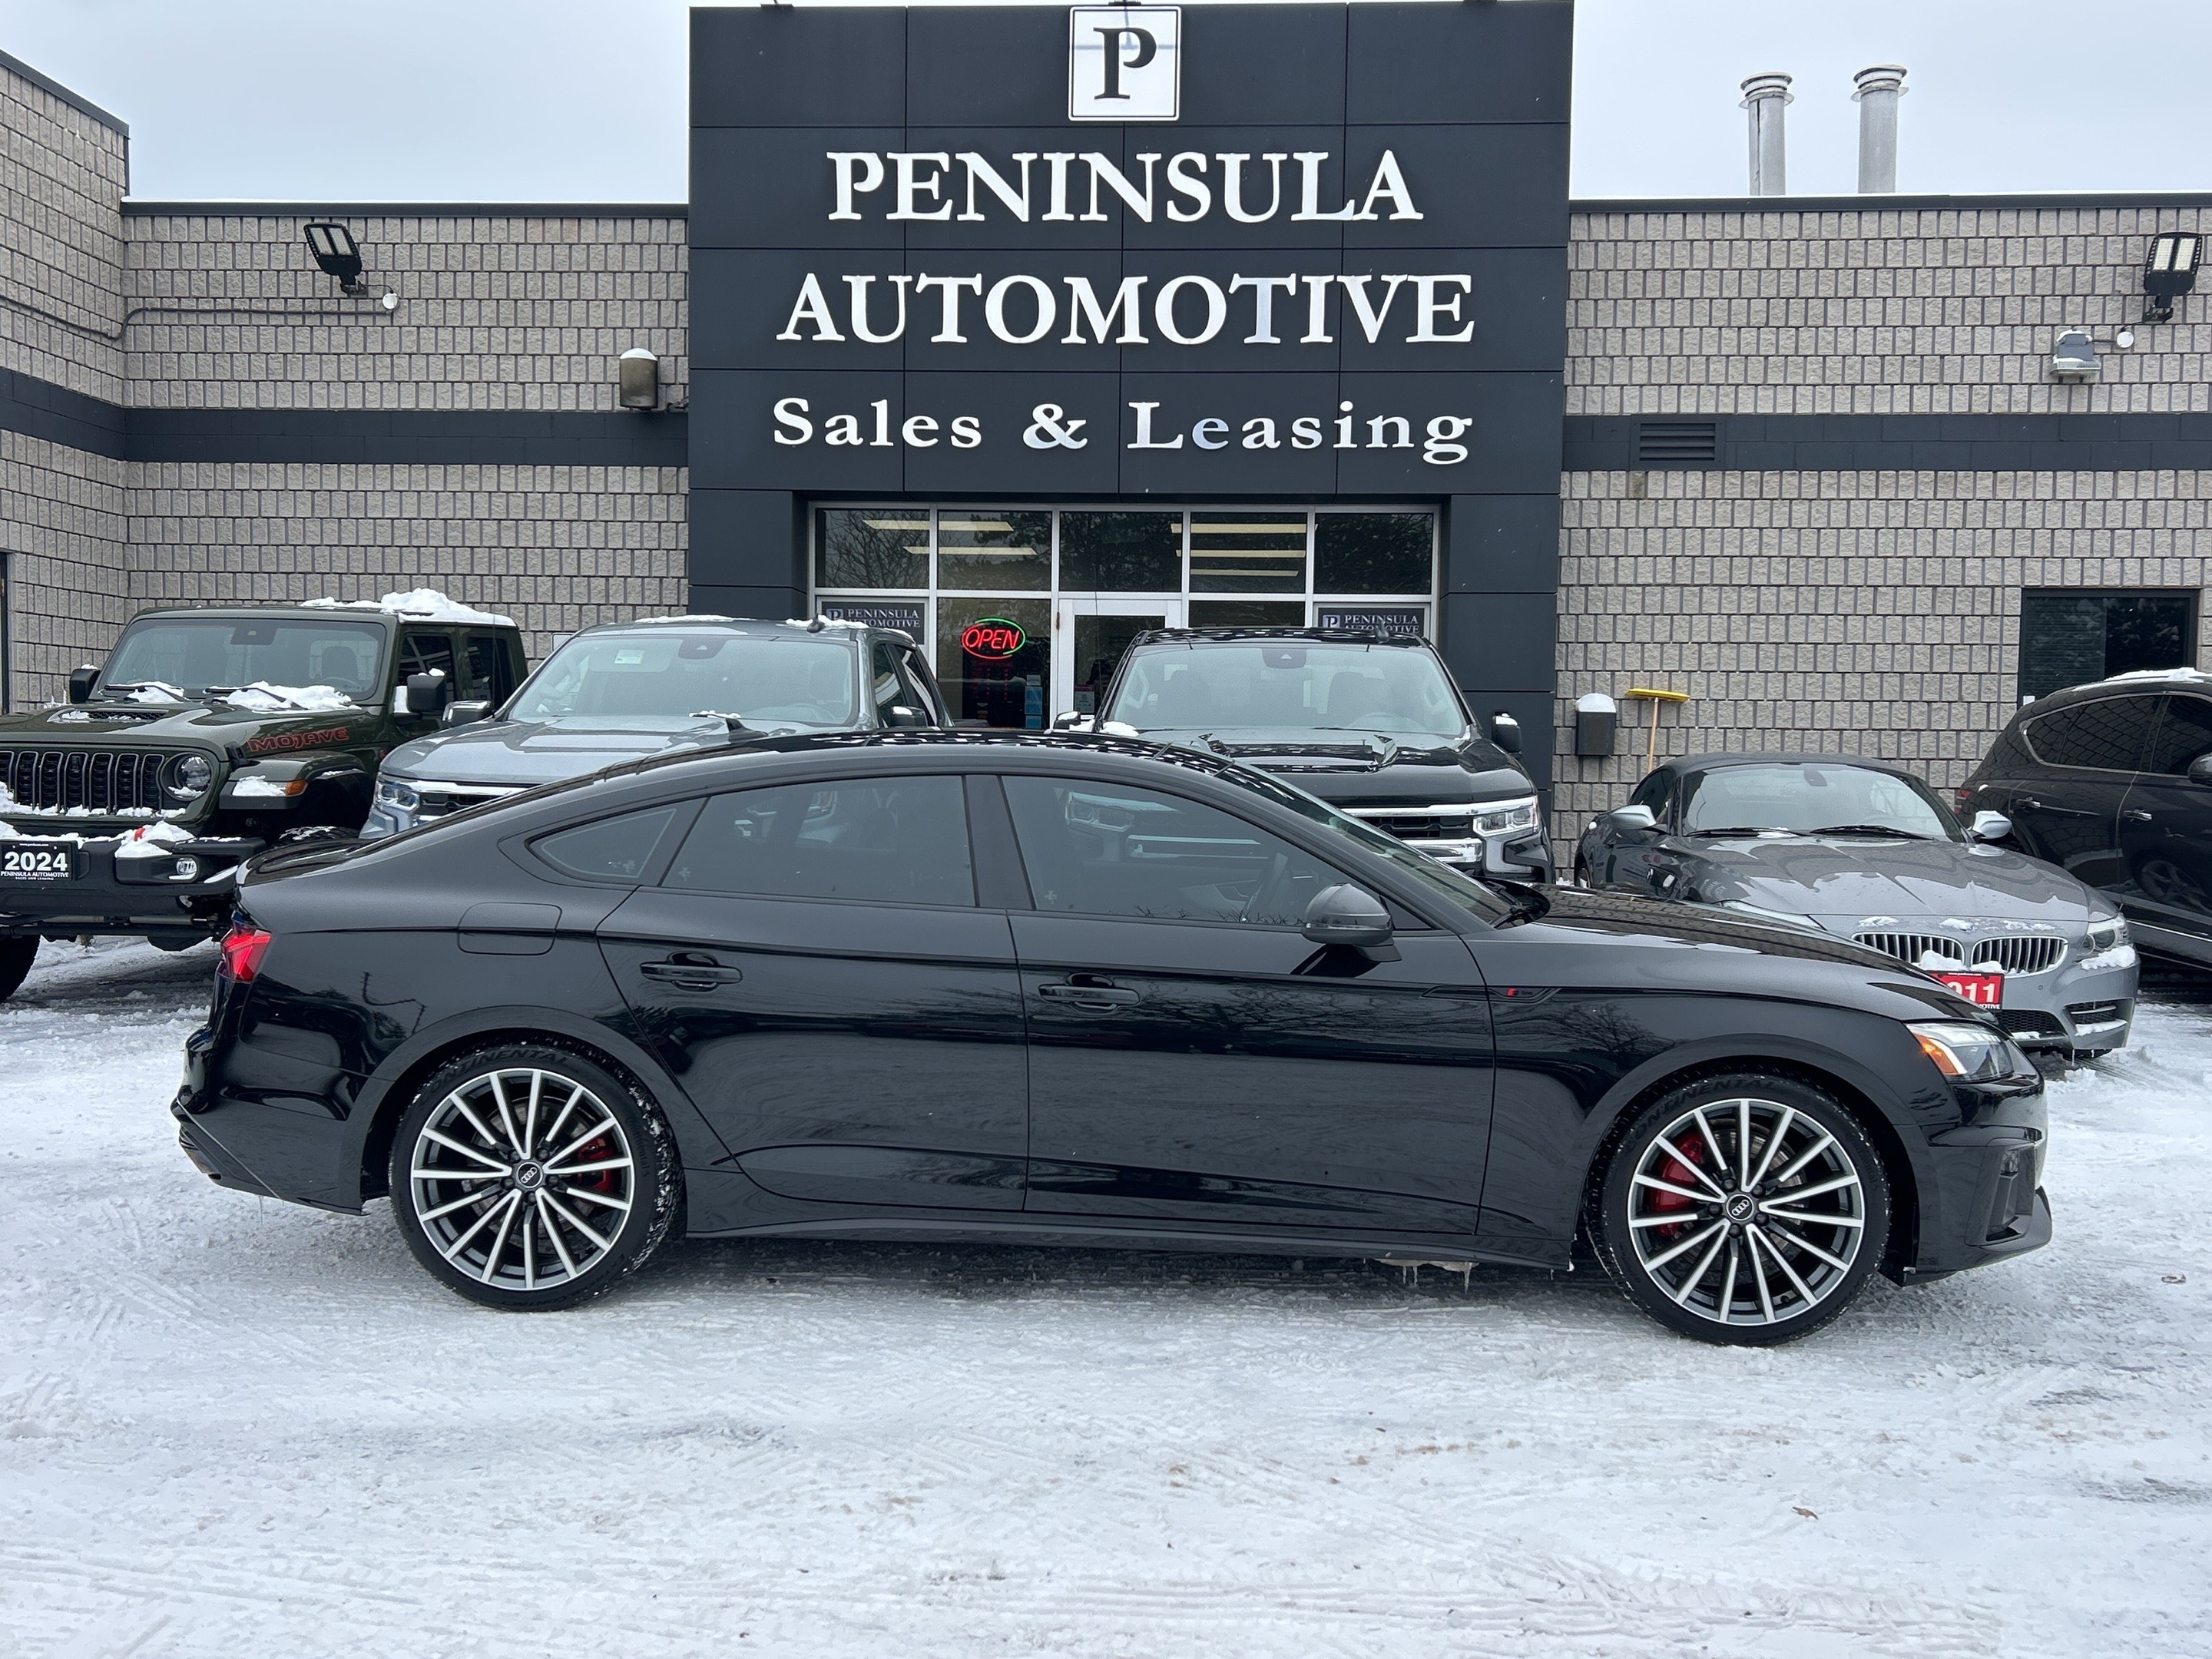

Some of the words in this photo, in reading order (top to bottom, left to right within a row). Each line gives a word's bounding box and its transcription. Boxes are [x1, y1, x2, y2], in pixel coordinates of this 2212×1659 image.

[1094, 28, 1156, 99] P
[826, 150, 1423, 223] PENINSULA
[777, 273, 1474, 344] AUTOMOTIVE
[774, 398, 981, 448] Sales
[1023, 404, 1088, 449] &
[1128, 401, 1472, 464] Leasing
[847, 608, 919, 619] PENINSULA
[849, 618, 920, 628] TOMOTIVE
[1344, 614, 1418, 624] PENINSULA
[965, 629, 1020, 649] OPEN
[247, 727, 349, 752] MOJAVE
[5, 851, 68, 871] 2024
[417, 1049, 571, 1106] CONTINENTAL
